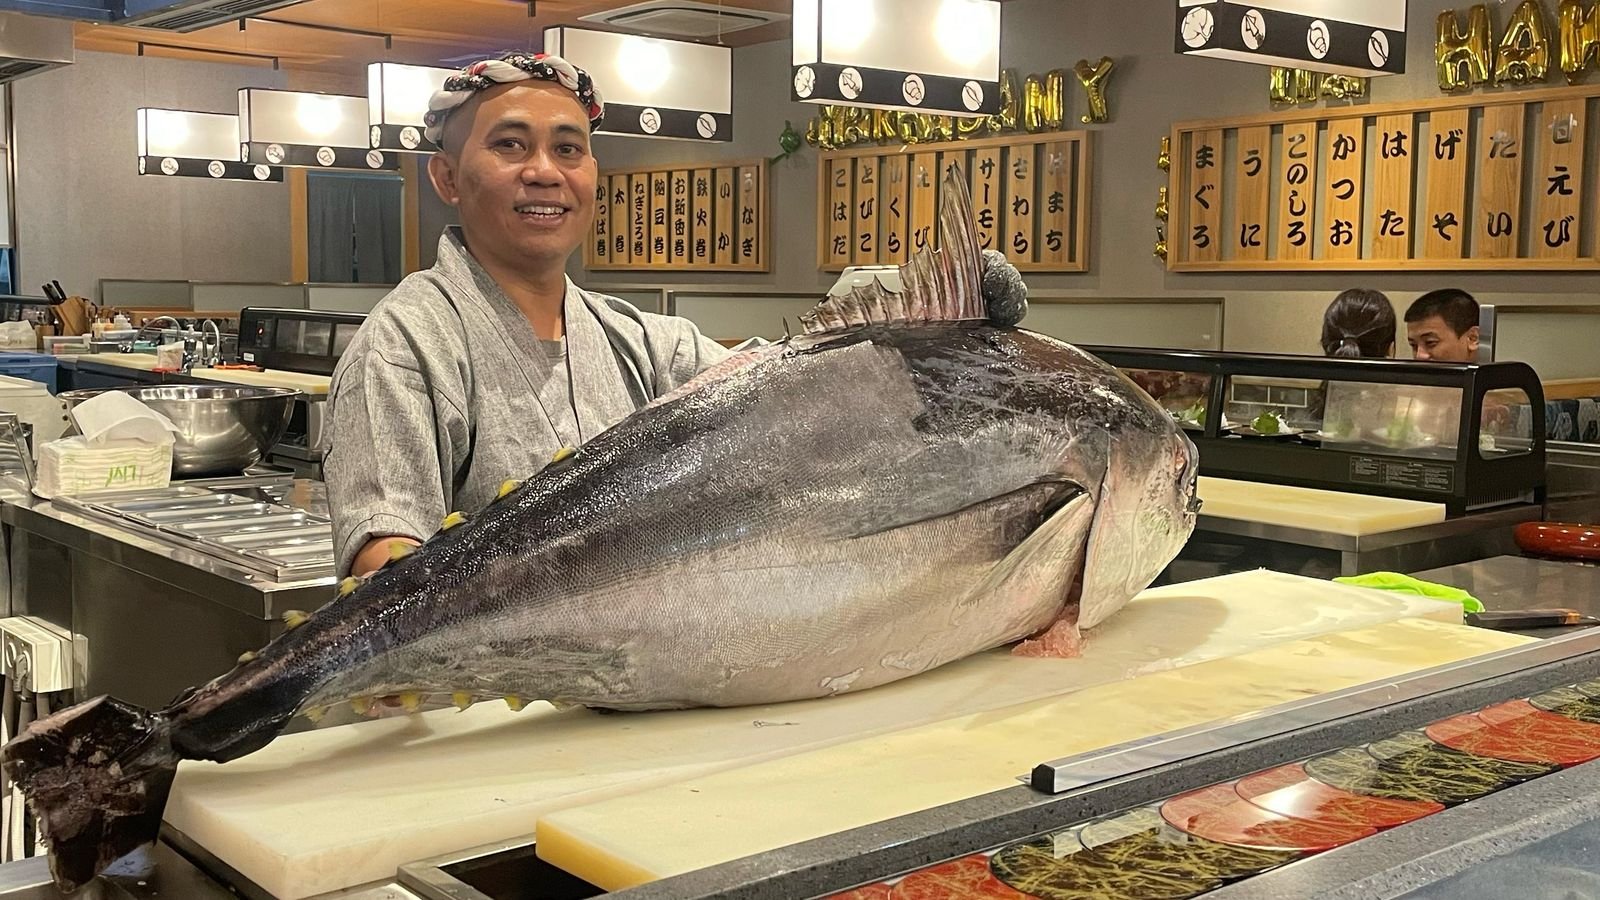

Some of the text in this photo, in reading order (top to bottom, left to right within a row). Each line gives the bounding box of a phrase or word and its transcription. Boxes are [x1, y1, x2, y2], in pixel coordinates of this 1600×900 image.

[718, 182, 730, 251] いか
[833, 168, 848, 255] こはだ
[860, 165, 875, 252] とびこ
[978, 157, 996, 250] サーモン
[1012, 157, 1029, 255] さわら
[1192, 145, 1214, 249] まぐろ
[1240, 149, 1262, 248] うに
[1286, 133, 1309, 247] このしろ
[1330, 133, 1356, 246] かつお
[1380, 130, 1408, 236] はた
[1432, 128, 1463, 241] げそ
[1487, 129, 1517, 237] たい
